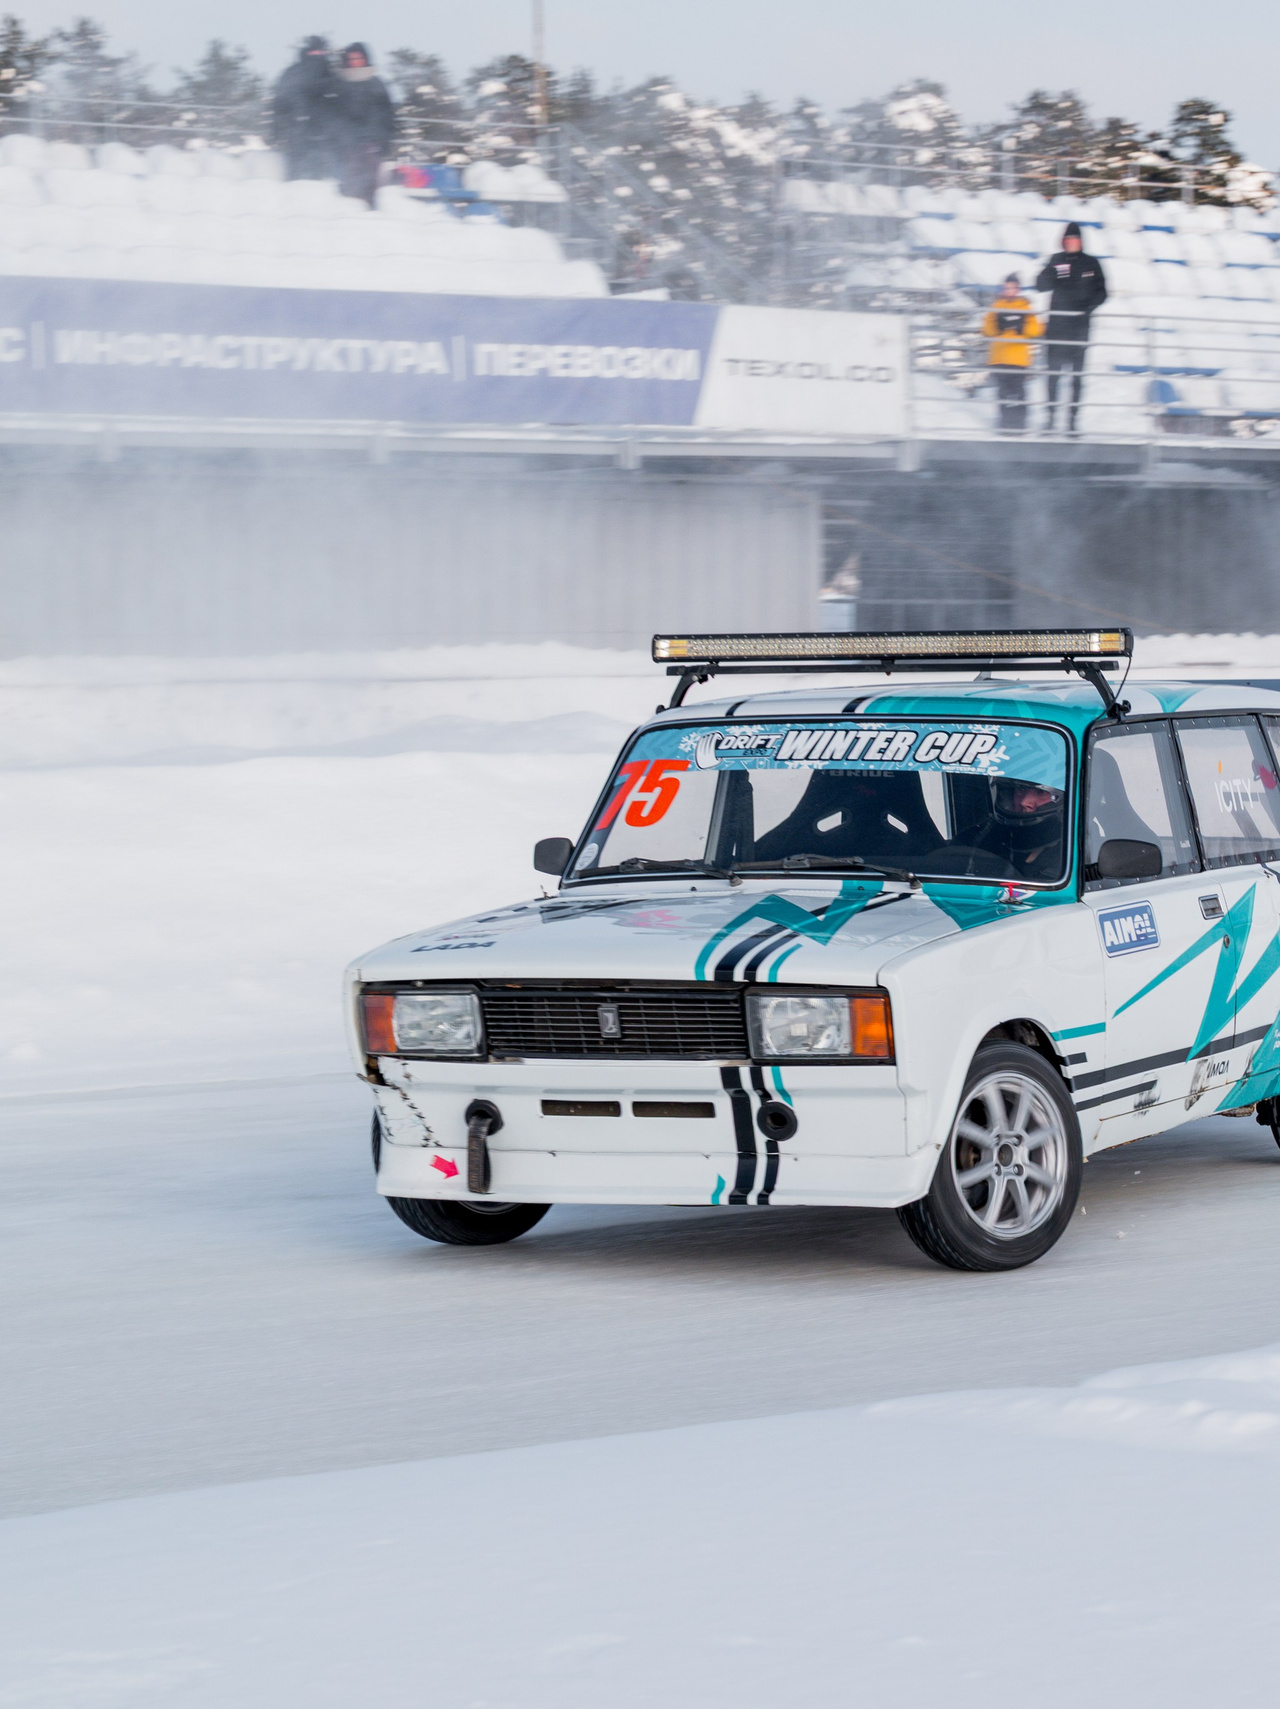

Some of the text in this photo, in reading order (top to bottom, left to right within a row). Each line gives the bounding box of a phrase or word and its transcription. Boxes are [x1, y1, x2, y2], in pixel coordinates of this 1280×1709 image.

[53, 330, 448, 374] ИНФРАСТРУКТУРА
[474, 343, 700, 380] ПЕРЕВОЗКИ
[718, 730, 998, 764] DRIFT WINTER CUP
[595, 758, 690, 831] 75
[409, 941, 496, 953] LADA
[1103, 913, 1156, 947] AIMOL
